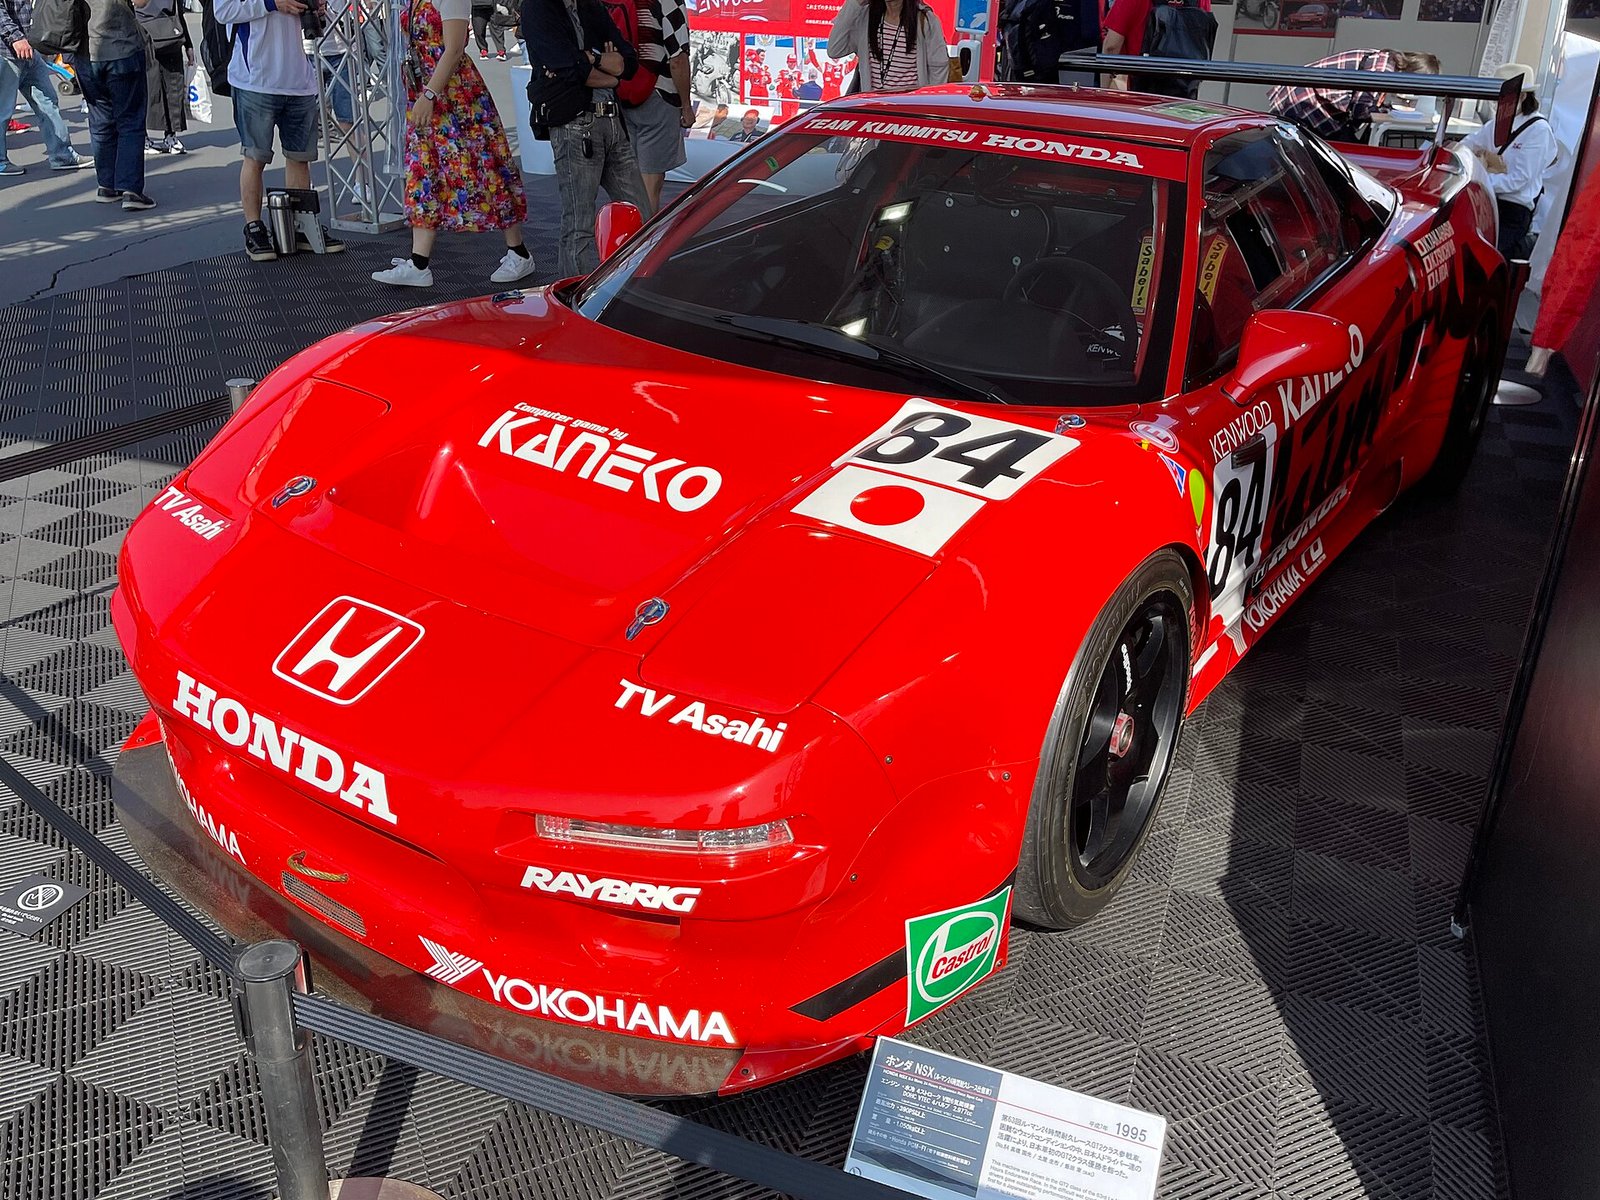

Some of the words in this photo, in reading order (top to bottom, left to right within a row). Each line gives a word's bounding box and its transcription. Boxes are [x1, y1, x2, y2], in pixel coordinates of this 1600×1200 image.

[804, 118, 857, 132] TEAM
[858, 121, 979, 144] KUNIMITSU
[982, 134, 1144, 169] HONDA
[1135, 245, 1153, 306] Sabelt
[513, 401, 574, 423] Computer
[569, 416, 609, 434] game
[608, 427, 629, 440] by
[1208, 400, 1273, 464] KENWOOD
[477, 410, 723, 513] KANEKO
[855, 411, 1055, 489] 84
[153, 485, 193, 511] TV
[171, 504, 231, 541] Asahi
[1208, 447, 1267, 602] 84
[1242, 564, 1306, 633] YOKOHAMA
[614, 678, 677, 717] TV
[668, 700, 788, 753] Asahi
[172, 670, 398, 825] HONDA
[520, 865, 702, 913] RAYBRIG
[931, 928, 995, 980] Castrol
[482, 968, 736, 1044] YOKOHAMA
[885, 1055, 913, 1072] ホンダ
[915, 1063, 934, 1078] NSX
[903, 1091, 916, 1099] DOHC
[917, 1095, 930, 1103] VTEC
[1114, 1122, 1147, 1142] 1995
